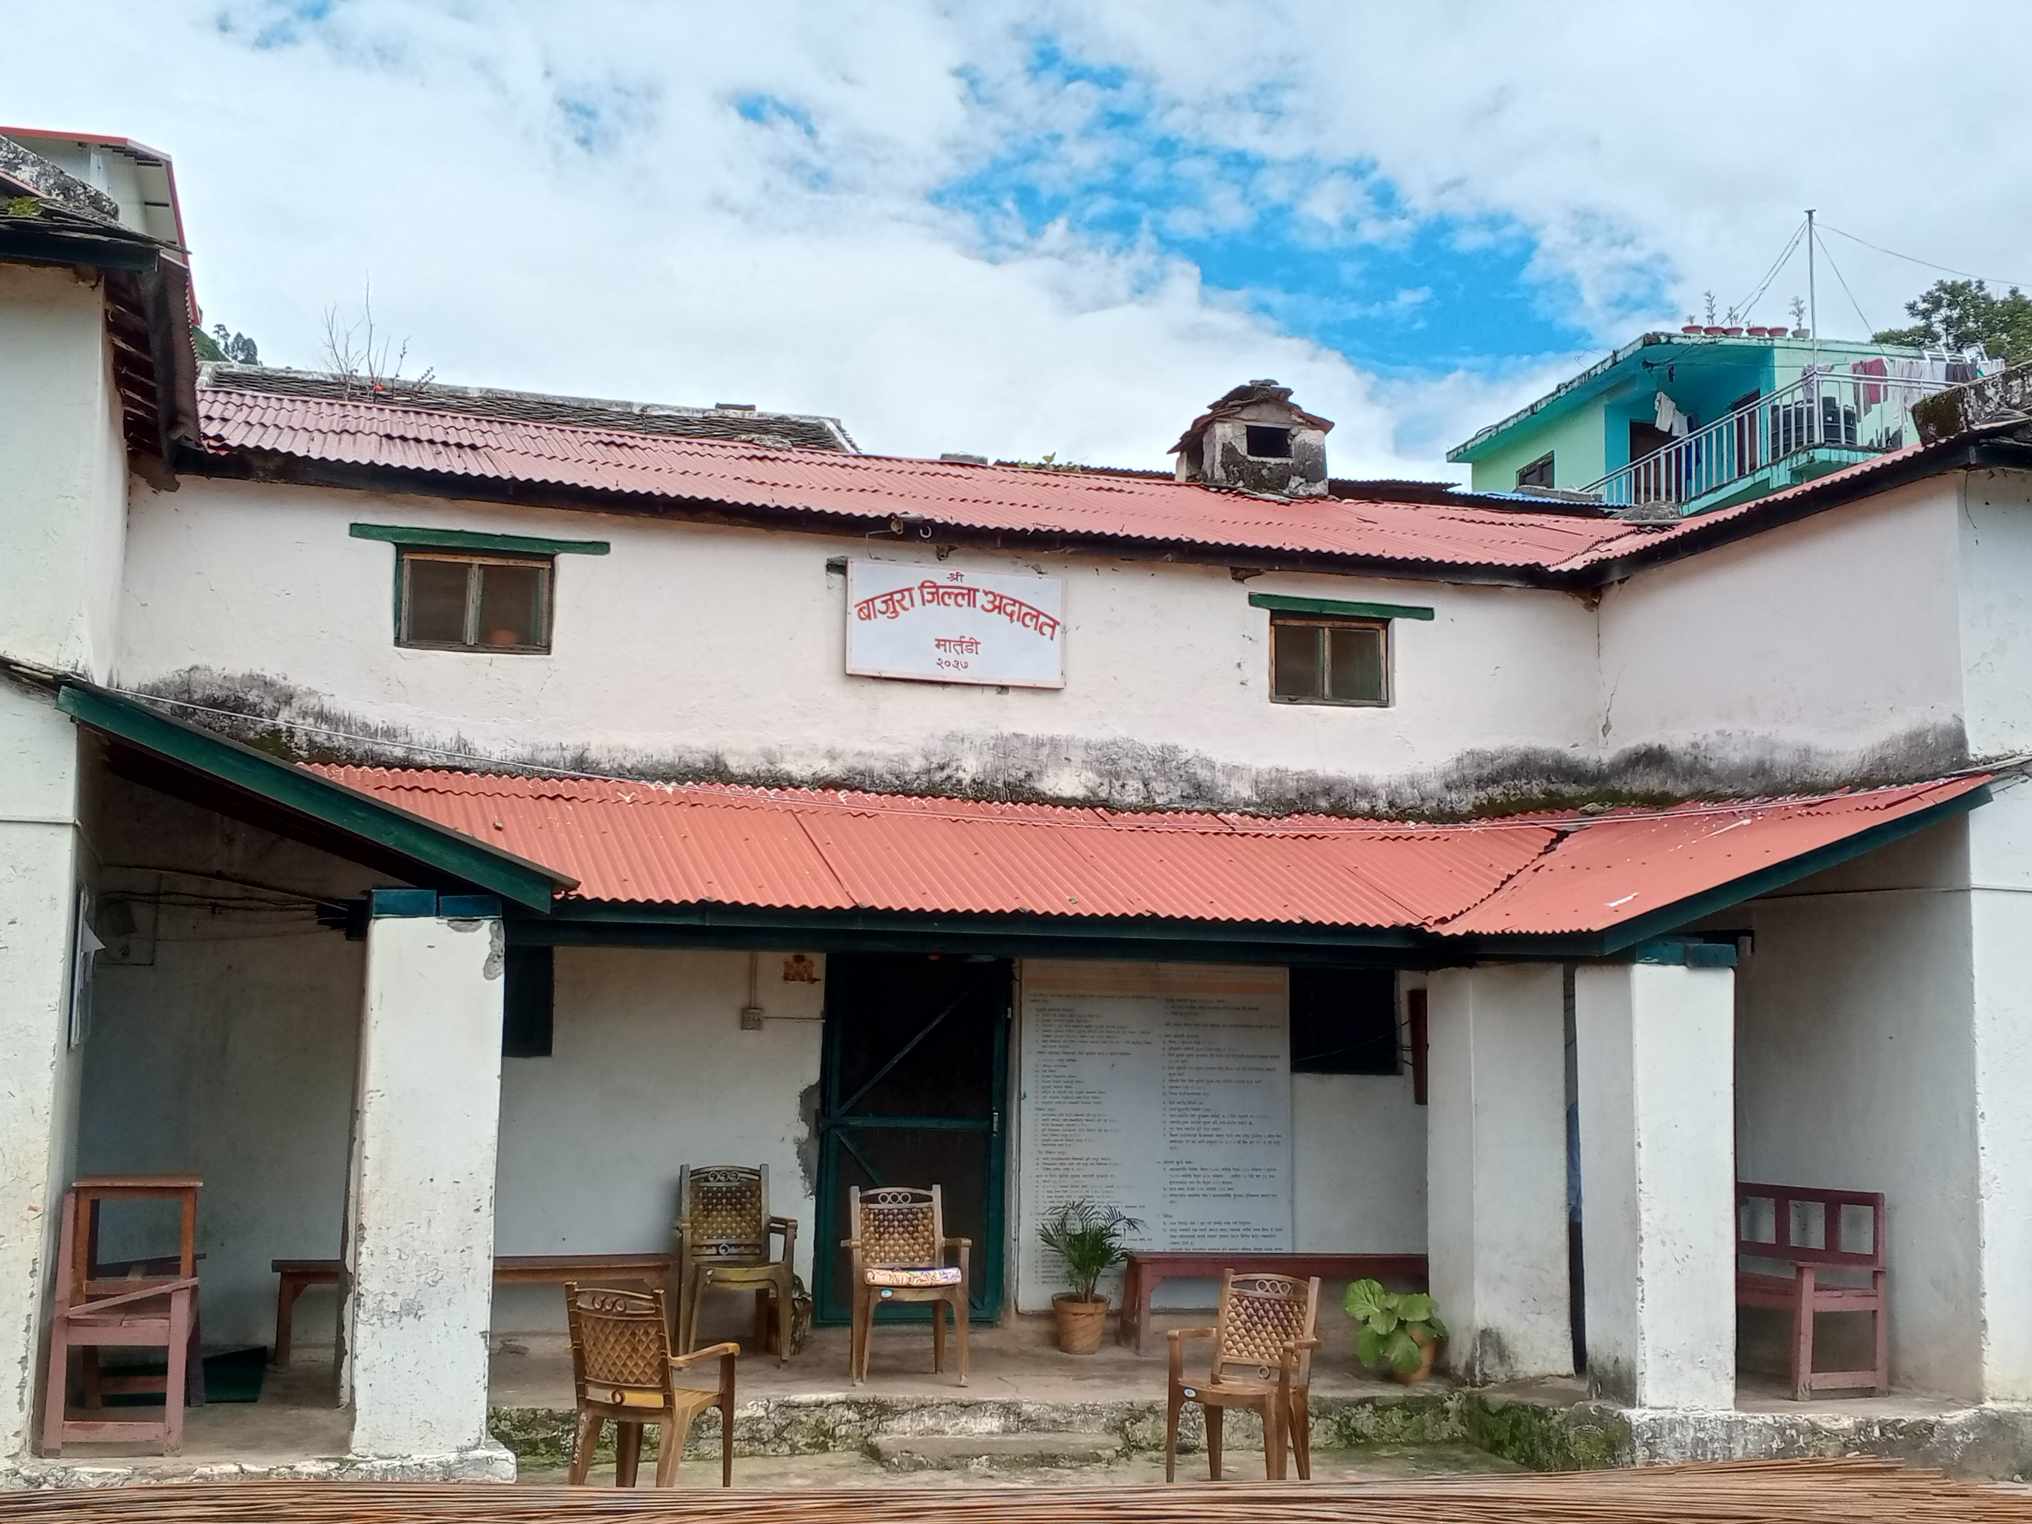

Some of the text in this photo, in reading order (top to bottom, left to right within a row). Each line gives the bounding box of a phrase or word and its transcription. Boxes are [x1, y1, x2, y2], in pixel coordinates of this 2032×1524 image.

[947, 571, 965, 583] श्री
[854, 579, 1061, 641] बाजुरा जिल्ला अदालत
